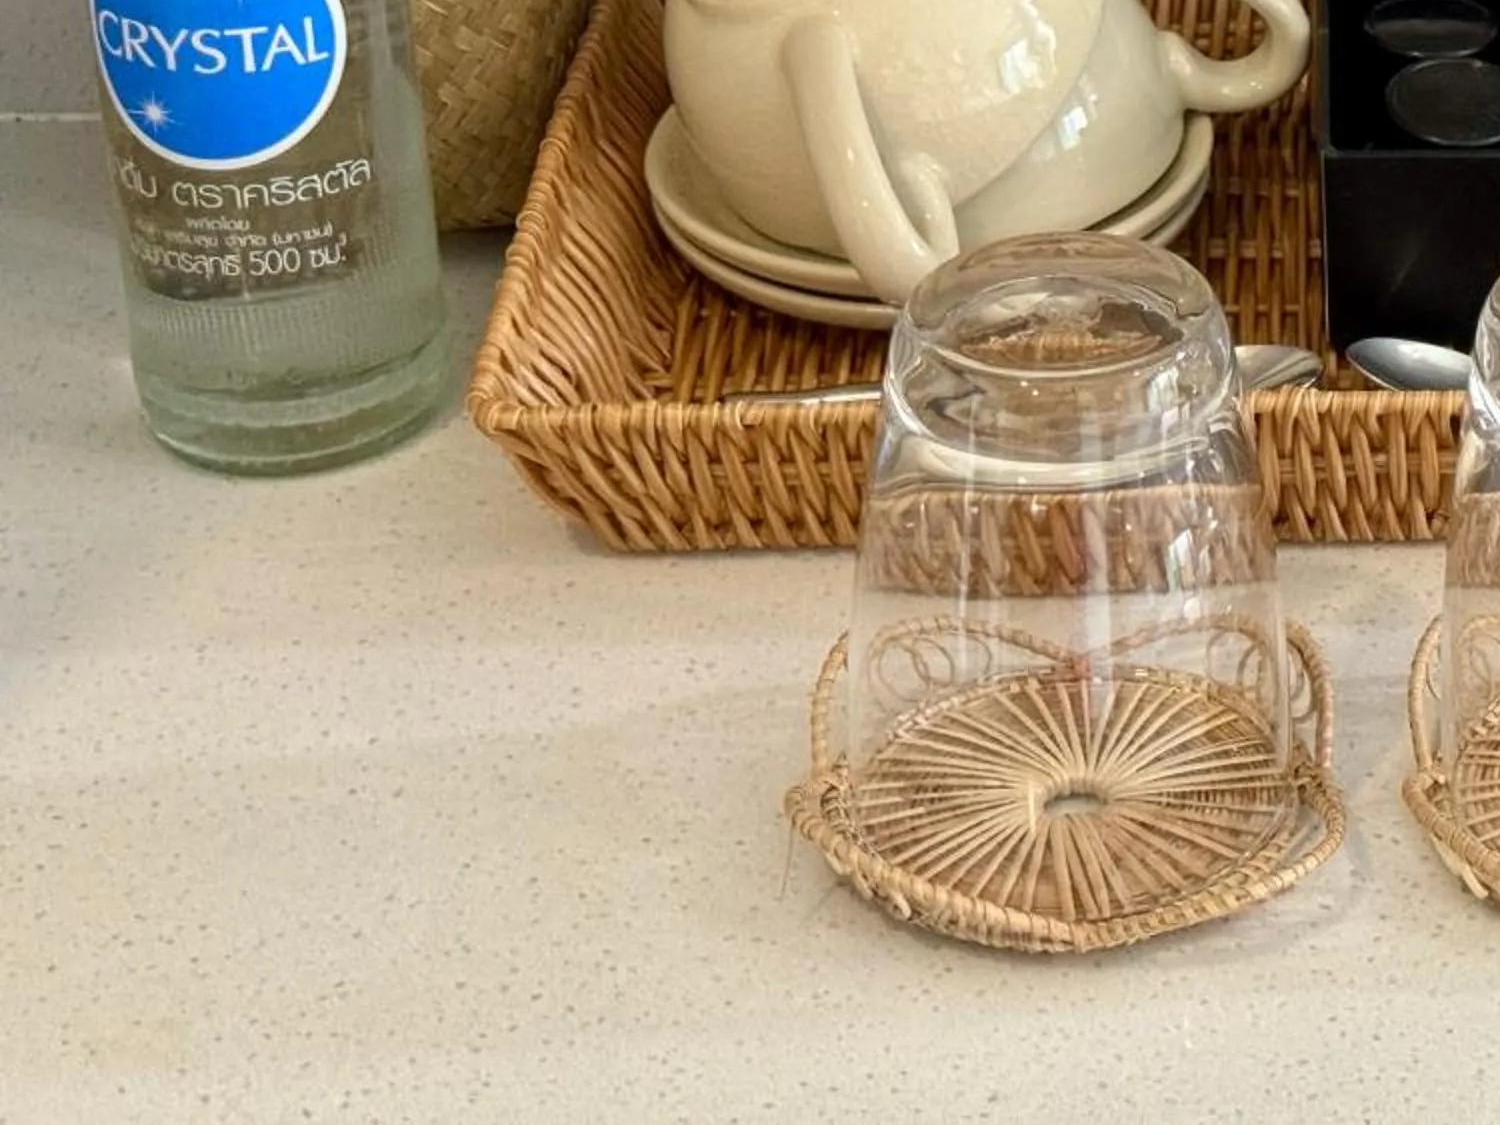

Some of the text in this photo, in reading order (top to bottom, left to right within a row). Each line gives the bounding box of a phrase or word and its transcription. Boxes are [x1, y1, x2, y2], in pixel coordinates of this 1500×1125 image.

[97, 8, 331, 76] CRYSTAL
[171, 157, 372, 210] ตราคริสตัล
[249, 247, 302, 278] 500
